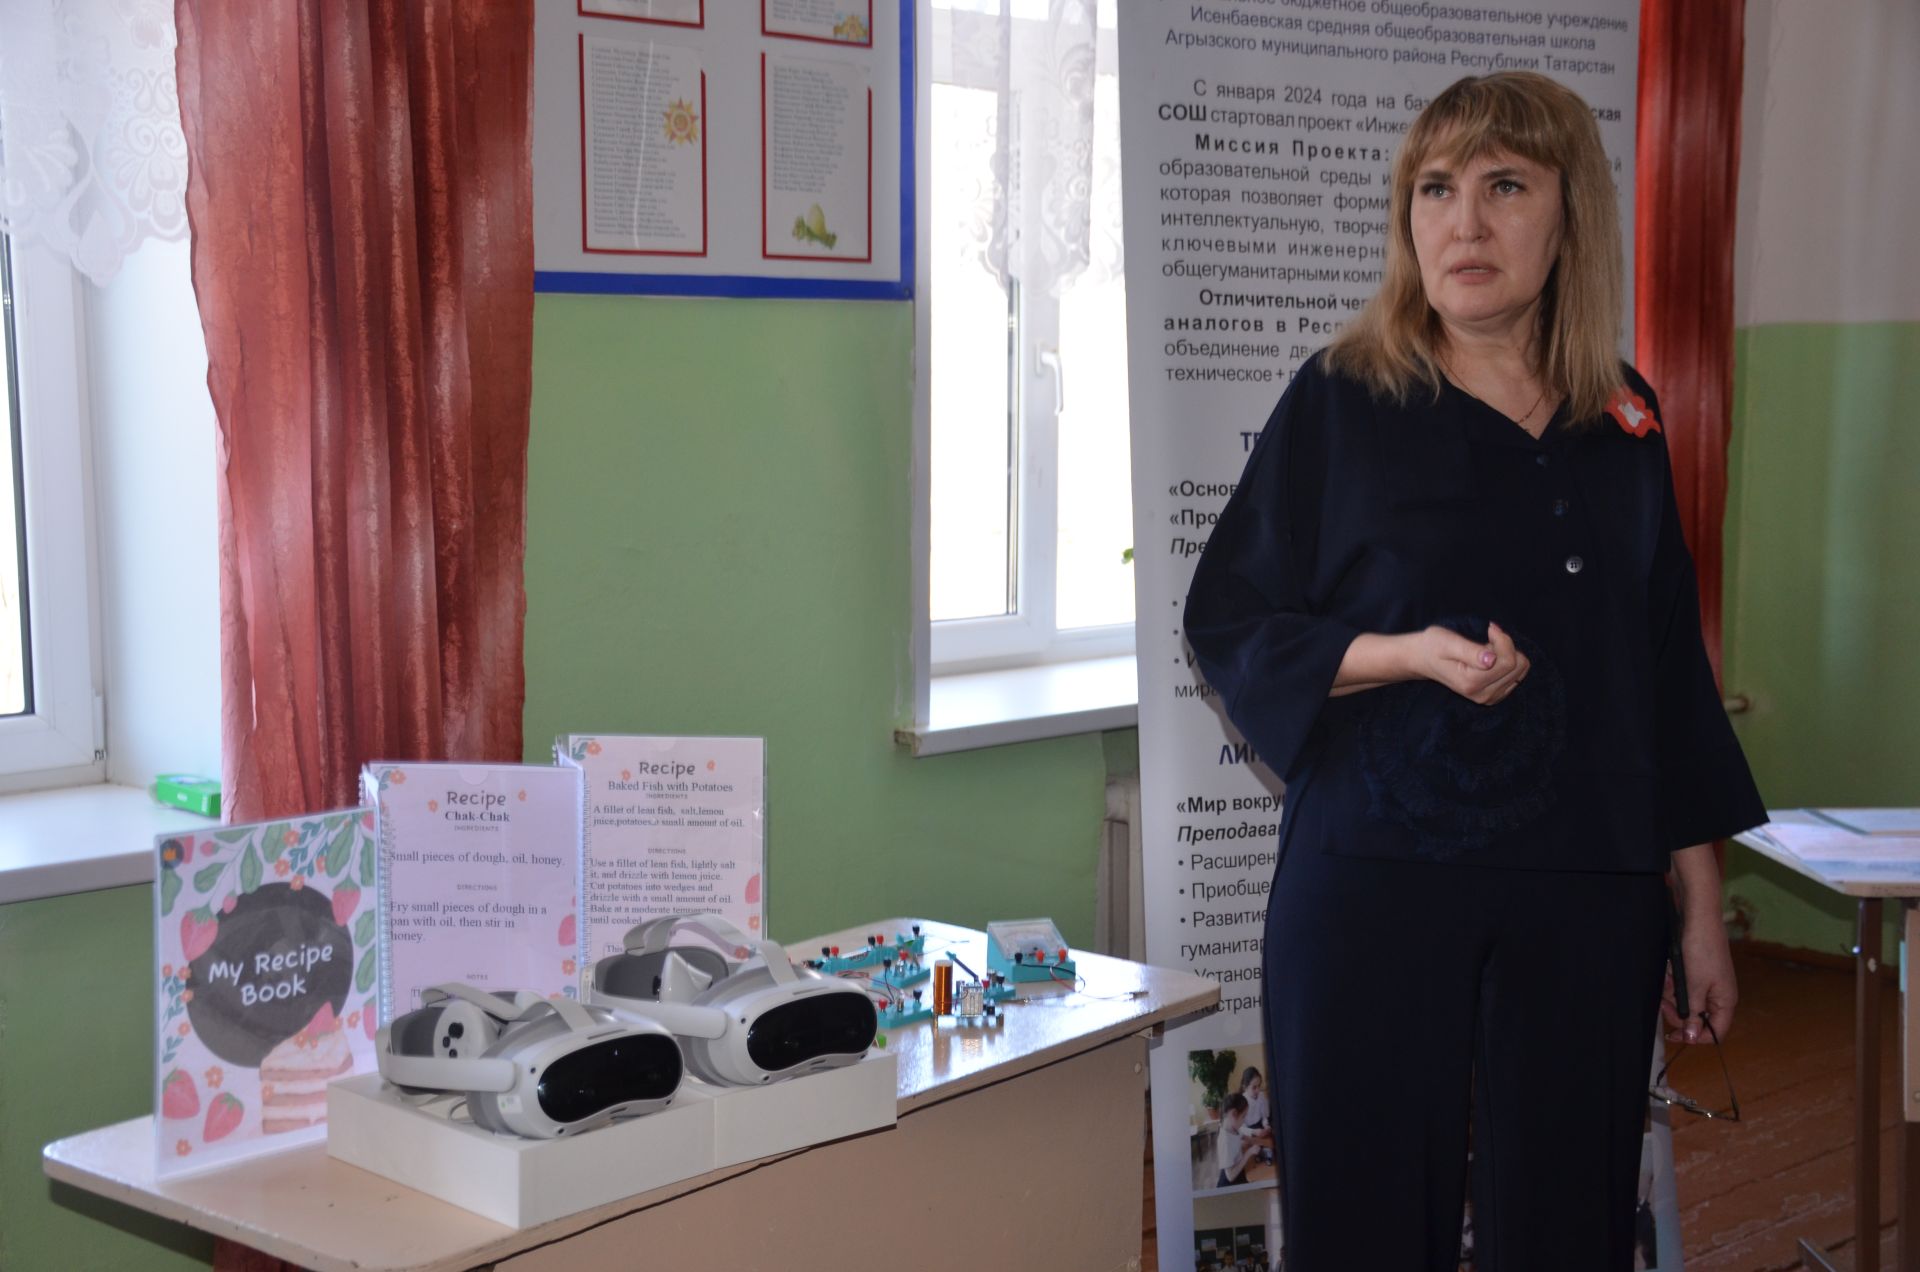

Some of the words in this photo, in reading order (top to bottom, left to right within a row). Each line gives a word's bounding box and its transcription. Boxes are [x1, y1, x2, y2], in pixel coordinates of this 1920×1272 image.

[1371, 0, 1543, 24] общеобразовательное
[1547, 13, 1629, 32] учреждение
[1191, 6, 1302, 30] Исенбаевская
[1307, 16, 1370, 36] средняя
[1375, 22, 1545, 47] общеобразовательная
[1550, 36, 1596, 50] школа
[1165, 29, 1256, 51] Агрызского
[1262, 38, 1389, 61] муниципального
[1393, 48, 1447, 65] района
[1451, 50, 1539, 71] Республики
[1544, 54, 1615, 74] Татарстан
[1193, 79, 1207, 97] С
[1216, 84, 1275, 103] января
[1284, 86, 1322, 105] 2024
[1331, 92, 1367, 110] года
[1376, 95, 1396, 109] на
[1158, 103, 1207, 123] СОШ
[1210, 109, 1295, 129] стартовал
[1297, 115, 1351, 133] проект
[1195, 133, 1279, 154] Миссия
[1292, 140, 1390, 162] Проекта:
[1159, 158, 1310, 182] образовательной
[1319, 169, 1372, 188] среды
[1160, 186, 1230, 204] которая
[1241, 189, 1323, 208] позволяет
[1160, 211, 1324, 235] интеллектуальную,
[1161, 237, 1276, 255] ключевыми
[1162, 259, 1340, 284] общегуманитарными
[1199, 289, 1337, 310] Отличительной
[1163, 316, 1264, 333] аналогов
[1276, 320, 1286, 333] в
[1164, 338, 1280, 360] объединение
[1166, 365, 1272, 383] техническое
[639, 760, 696, 779] Recipe
[608, 780, 639, 791] Baked
[642, 780, 664, 791] Fish
[667, 781, 689, 792] with
[692, 782, 733, 792] Potatoes
[446, 789, 507, 810] Recipe
[1177, 796, 1227, 816] «Мир
[444, 810, 511, 822] Chak-Chak
[603, 805, 624, 814] fillet
[626, 805, 635, 814] of
[637, 806, 655, 815] lean
[687, 819, 717, 827] amount
[719, 818, 729, 827] of
[422, 852, 455, 864] pieces
[458, 851, 470, 862] of
[590, 858, 607, 868] Use
[616, 858, 637, 868] fillet
[639, 859, 648, 868] of
[650, 859, 668, 868] lean
[691, 860, 718, 871] lightly
[720, 860, 736, 869] salt
[1191, 852, 1279, 871] Расширен
[601, 870, 617, 879] and
[619, 870, 648, 880] drizzle
[650, 871, 669, 880] with
[671, 871, 697, 880] lemon
[607, 883, 642, 892] potatoes
[645, 882, 661, 892] into
[663, 883, 695, 893] wedges
[698, 883, 713, 892] and
[1192, 879, 1270, 903] Приобще
[590, 893, 619, 902] drizzle
[622, 893, 641, 902] with
[650, 894, 673, 902] small
[675, 895, 705, 903] amount
[708, 895, 718, 904] of
[389, 901, 410, 914] Fry
[411, 901, 439, 912] small
[442, 902, 475, 915] pieces
[478, 902, 490, 913] of
[492, 903, 525, 917] dough
[528, 904, 538, 914] in
[541, 907, 547, 915] a
[590, 904, 612, 913] Bake
[614, 905, 622, 913] at
[631, 905, 670, 914] moderate
[389, 918, 410, 930] pan
[413, 916, 436, 927] with
[459, 917, 482, 928] then
[485, 917, 501, 928] stir
[504, 917, 515, 928] in
[590, 915, 609, 925] until
[208, 960, 244, 987] My
[255, 943, 333, 974] Recipe
[240, 973, 307, 1006] Book
